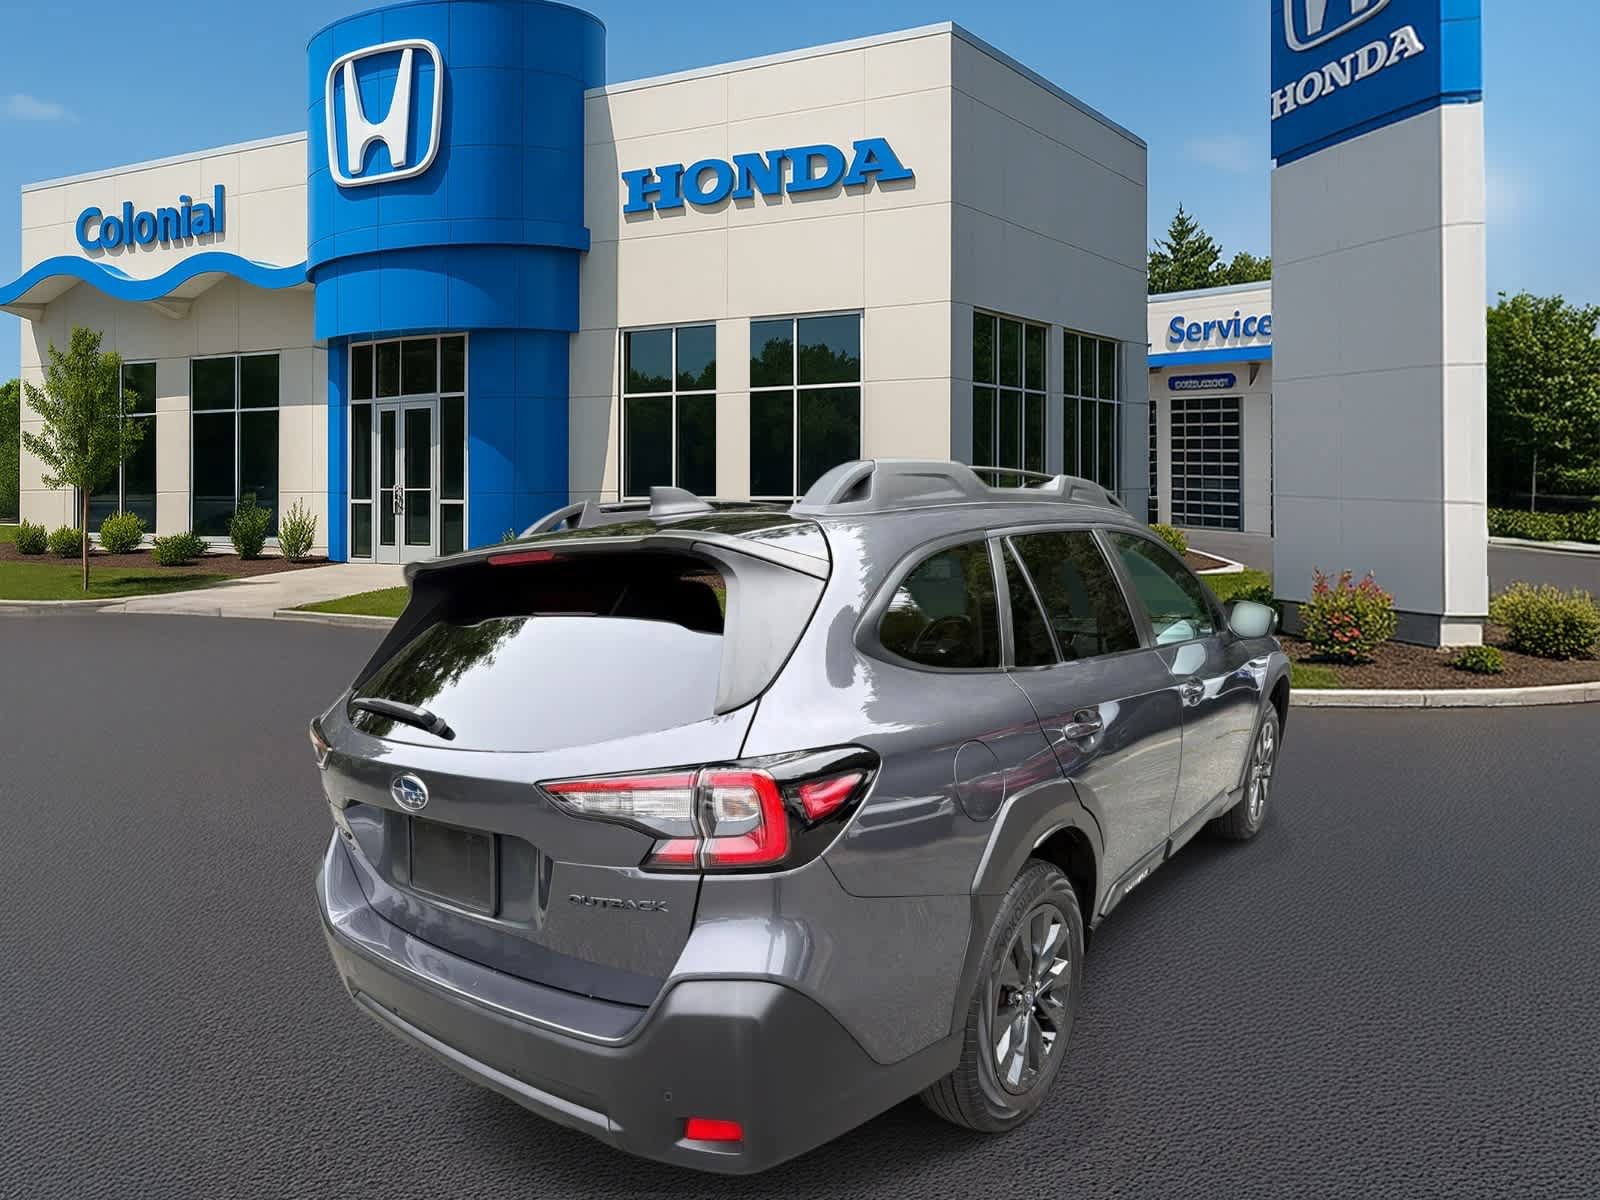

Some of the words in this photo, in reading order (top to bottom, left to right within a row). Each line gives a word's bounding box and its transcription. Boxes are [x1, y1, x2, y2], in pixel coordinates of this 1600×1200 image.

[1271, 25, 1425, 120] HONDA
[622, 137, 913, 213] HONDA
[76, 184, 225, 250] Colonial
[1169, 310, 1272, 343] Service
[568, 894, 669, 912] OUTBACK
